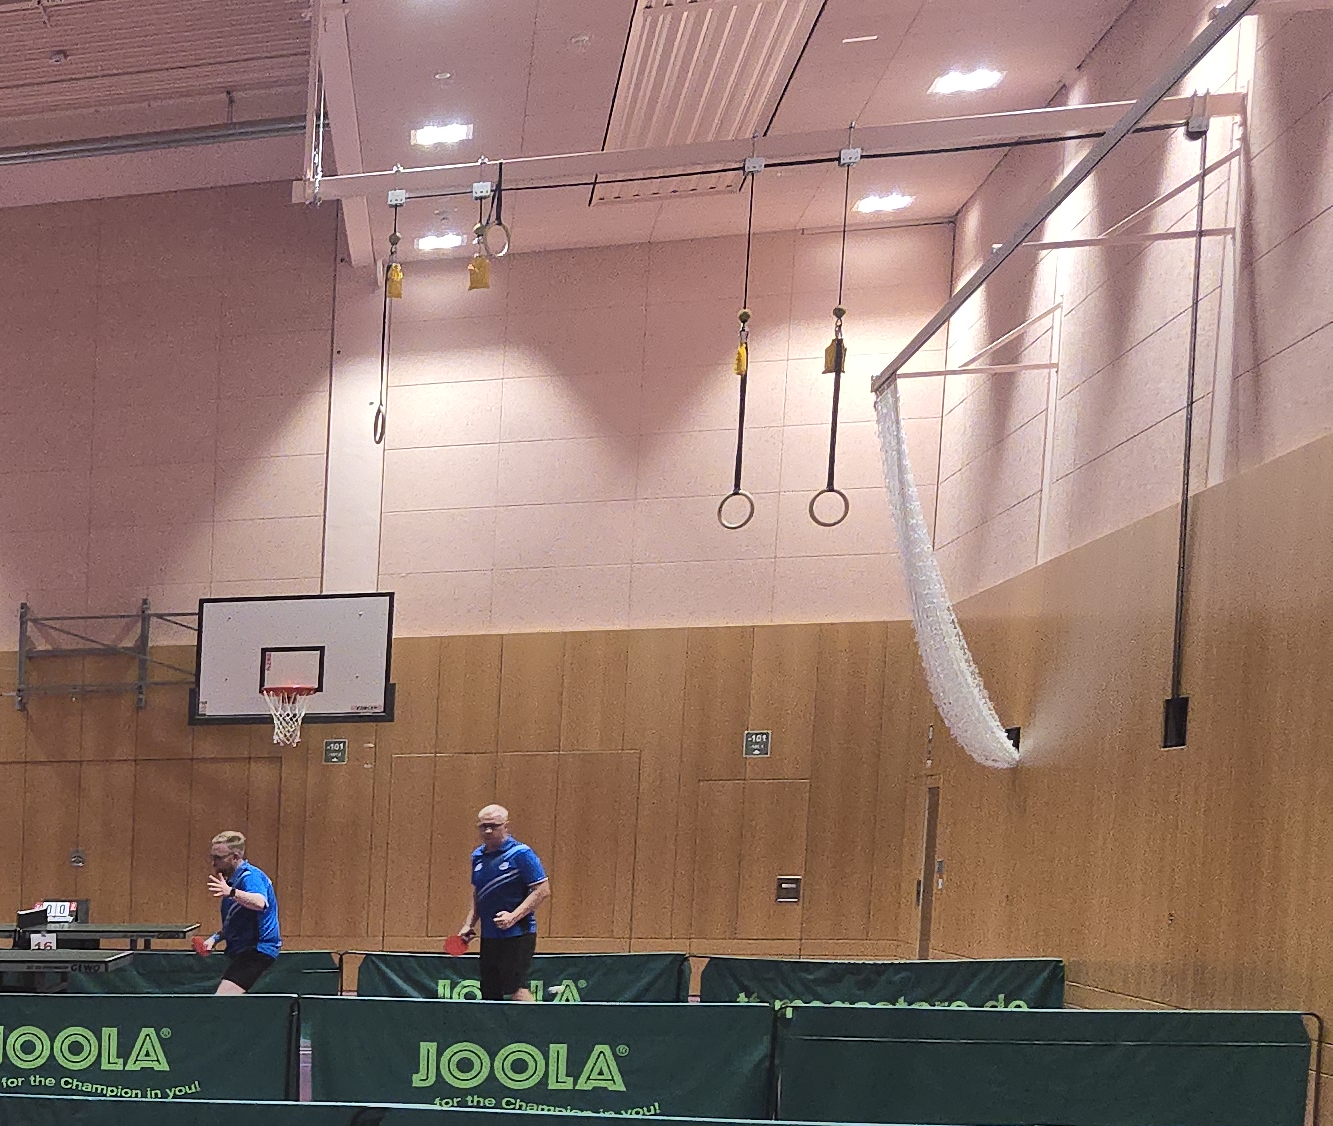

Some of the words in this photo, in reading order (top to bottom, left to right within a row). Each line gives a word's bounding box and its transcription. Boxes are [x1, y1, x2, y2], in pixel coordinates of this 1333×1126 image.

[71, 964, 100, 972] GEWO
[437, 980, 581, 1002] JOLA
[412, 1042, 626, 1092] JOOLA
[1, 1077, 25, 1088] for
[30, 1074, 56, 1086] the
[60, 1077, 141, 1099] Champion
[146, 1087, 162, 1099] in
[166, 1081, 201, 1100] you!
[434, 1097, 462, 1108] for
[466, 1095, 495, 1107] the
